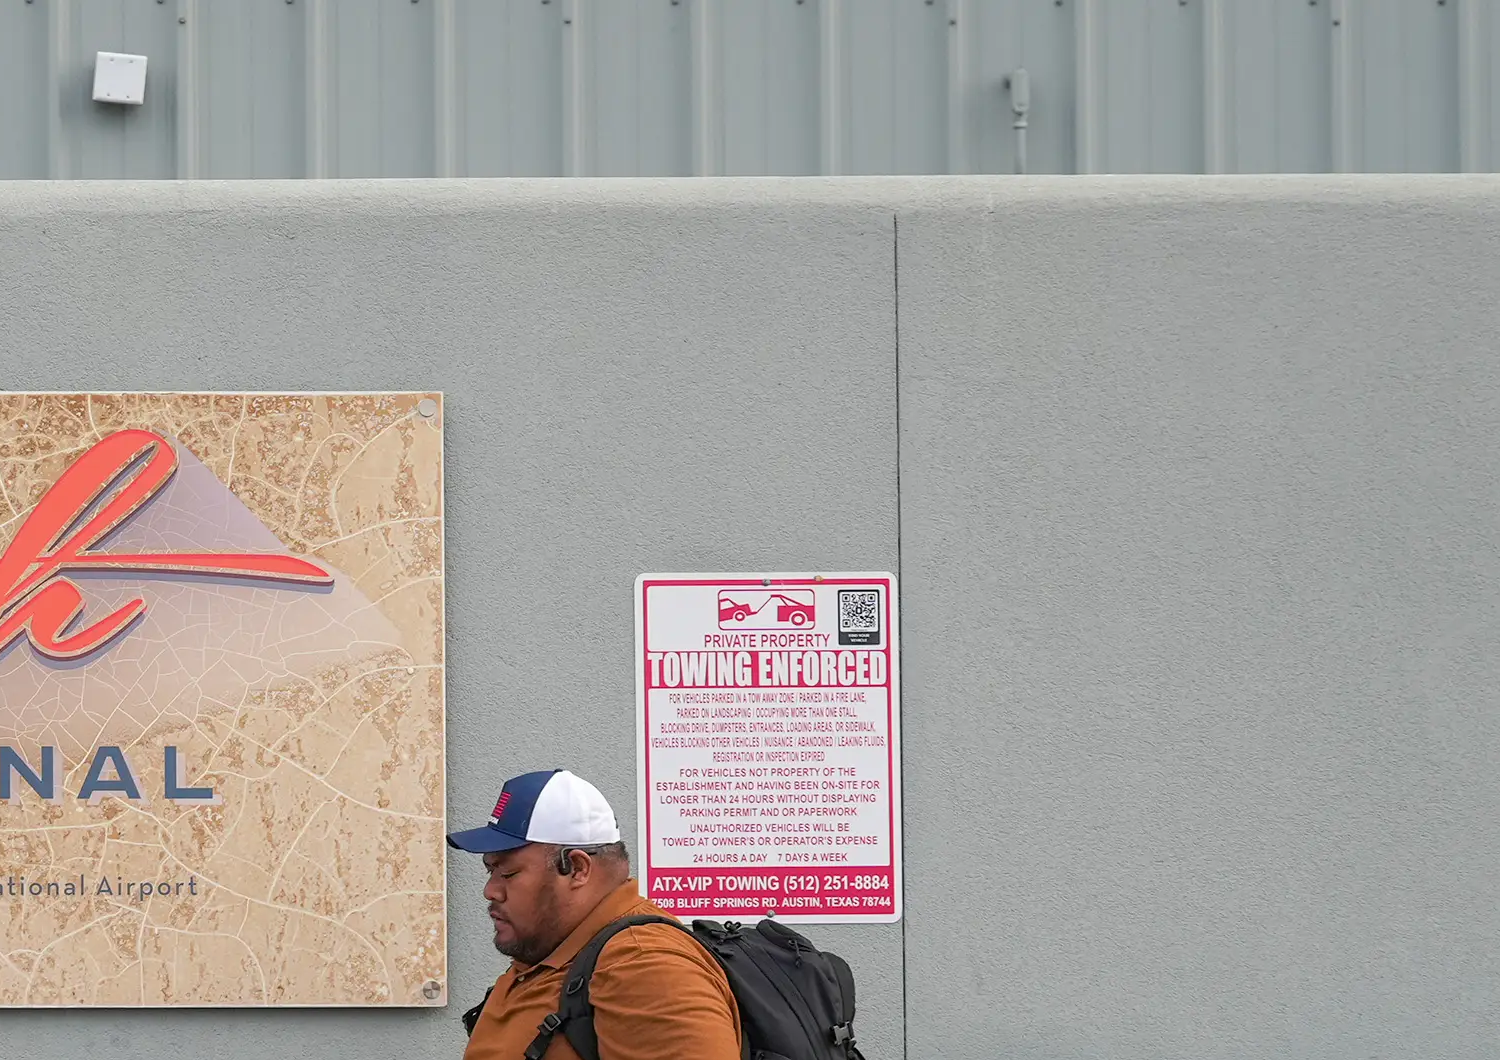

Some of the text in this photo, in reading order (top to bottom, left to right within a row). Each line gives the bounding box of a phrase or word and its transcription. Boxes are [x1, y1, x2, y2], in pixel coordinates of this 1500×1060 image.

[704, 633, 830, 648] PRIVATE PROPERTY
[648, 651, 886, 687] TOWING ENFORCED
[670, 694, 681, 703] FOR
[682, 694, 709, 703] VEHICLES
[712, 693, 734, 703] PARKED
[736, 693, 741, 703] IN
[743, 693, 746, 703] A
[748, 693, 760, 703] TOW
[762, 693, 777, 703] AWAY
[779, 693, 794, 702] ZONE
[799, 693, 822, 702] PARKED
[824, 693, 829, 702] IN
[831, 693, 834, 702] A
[836, 692, 848, 702] FIRE
[677, 708, 700, 718] PARKED
[701, 708, 709, 718] ON
[711, 708, 751, 718] LANDSCAPING
[756, 708, 789, 718] OCCUPYING
[791, 707, 807, 717] MORE
[809, 707, 823, 717] THAN
[826, 707, 837, 717] ONE
[661, 723, 690, 733] BLOCKING
[787, 722, 812, 732] LOADING
[835, 722, 844, 732] OR
[651, 738, 679, 747] VEHICLES
[681, 738, 710, 747] BLOCKING
[711, 737, 731, 747] OTHER
[732, 737, 760, 747] VEHICLES
[765, 737, 793, 747] NUISANCE
[798, 737, 833, 746] ABANDONED
[838, 737, 863, 746] LEAKING
[713, 751, 825, 762] REGISTRATION OR INSPECTION EXPIRED
[680, 768, 856, 777] FOR VEHICLES NOT PROPERTY OF THE
[656, 781, 880, 791] ESTABLISHMENT AND HAVING BEEN ON-SITE FOR
[660, 794, 876, 804] LONGER THAN 24 HOURS WITHOUT DISPLAYING
[680, 808, 857, 817] PARKING PERMIT AND OR PAPERWORK
[690, 823, 850, 833] UNAUTHORIZED VEHICLES WILL BE
[662, 836, 878, 846] TOWED AT OWNER'S OR OPERATOR'S EXPENSE
[693, 853, 848, 862] 24 HOURS A DAY 7 DAYS A WEEK
[96, 874, 198, 902] Airport
[653, 875, 889, 894] ATX-VIP TOWING (512) 251-8884
[677, 898, 710, 908] BLUFF
[713, 898, 759, 908] SPRINGS
[761, 898, 779, 907] RD.
[782, 897, 823, 909] AUSTIN,
[825, 897, 860, 907] TEXAS
[862, 897, 891, 907] 78744
